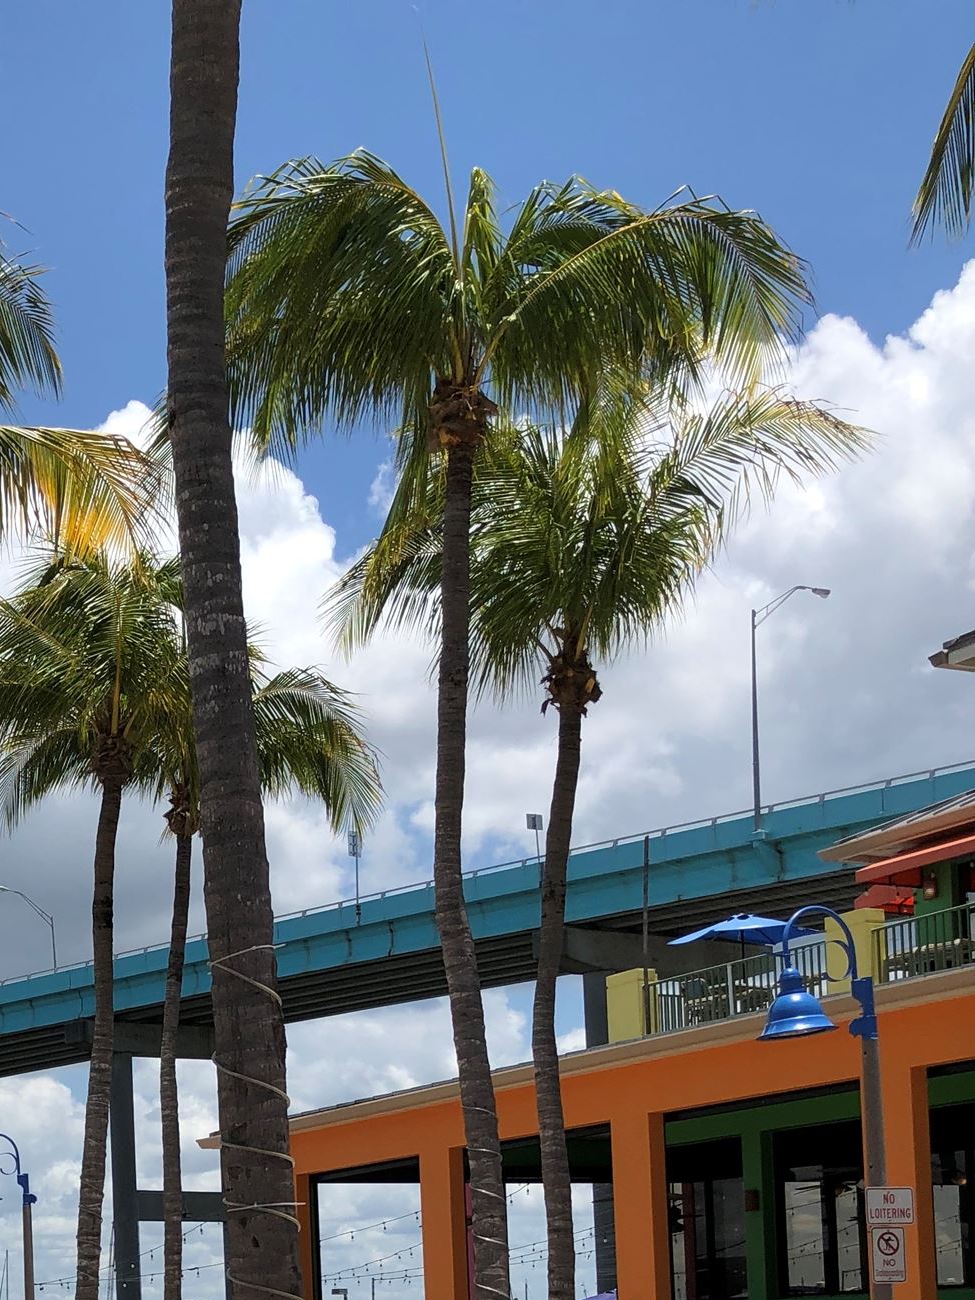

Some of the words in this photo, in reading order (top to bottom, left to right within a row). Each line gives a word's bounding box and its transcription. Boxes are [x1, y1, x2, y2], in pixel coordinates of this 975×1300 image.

[883, 1193, 895, 1204] NO
[869, 1208, 911, 1219] LOITERING
[883, 1259, 896, 1267] NO
